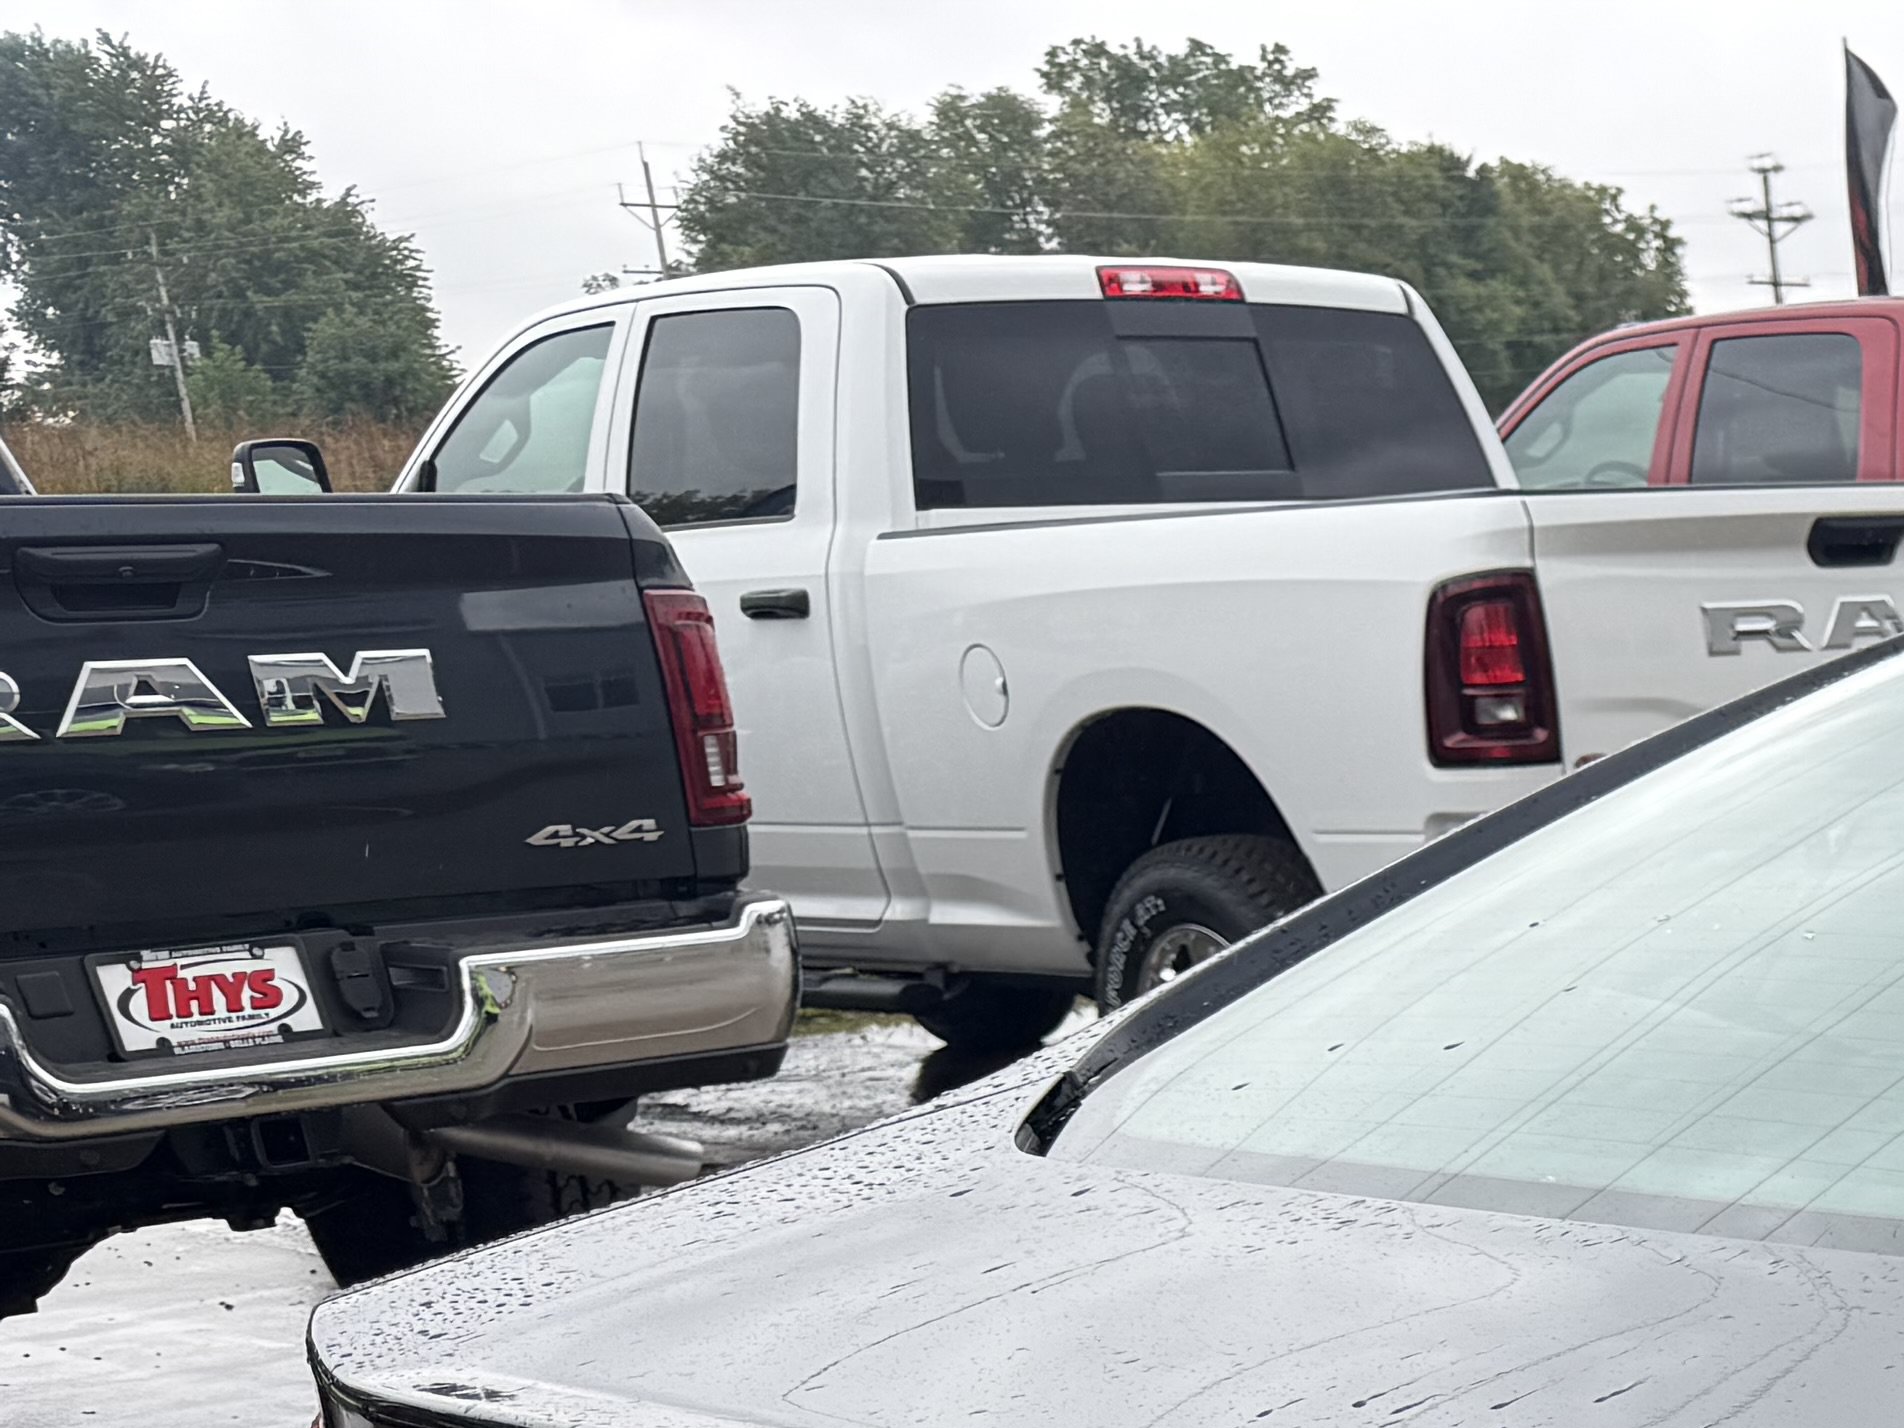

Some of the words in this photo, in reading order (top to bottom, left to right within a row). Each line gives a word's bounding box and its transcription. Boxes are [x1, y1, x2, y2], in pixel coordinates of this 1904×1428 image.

[0, 648, 446, 741] AM
[525, 818, 665, 849] 4x4
[132, 962, 284, 1022] THYS
